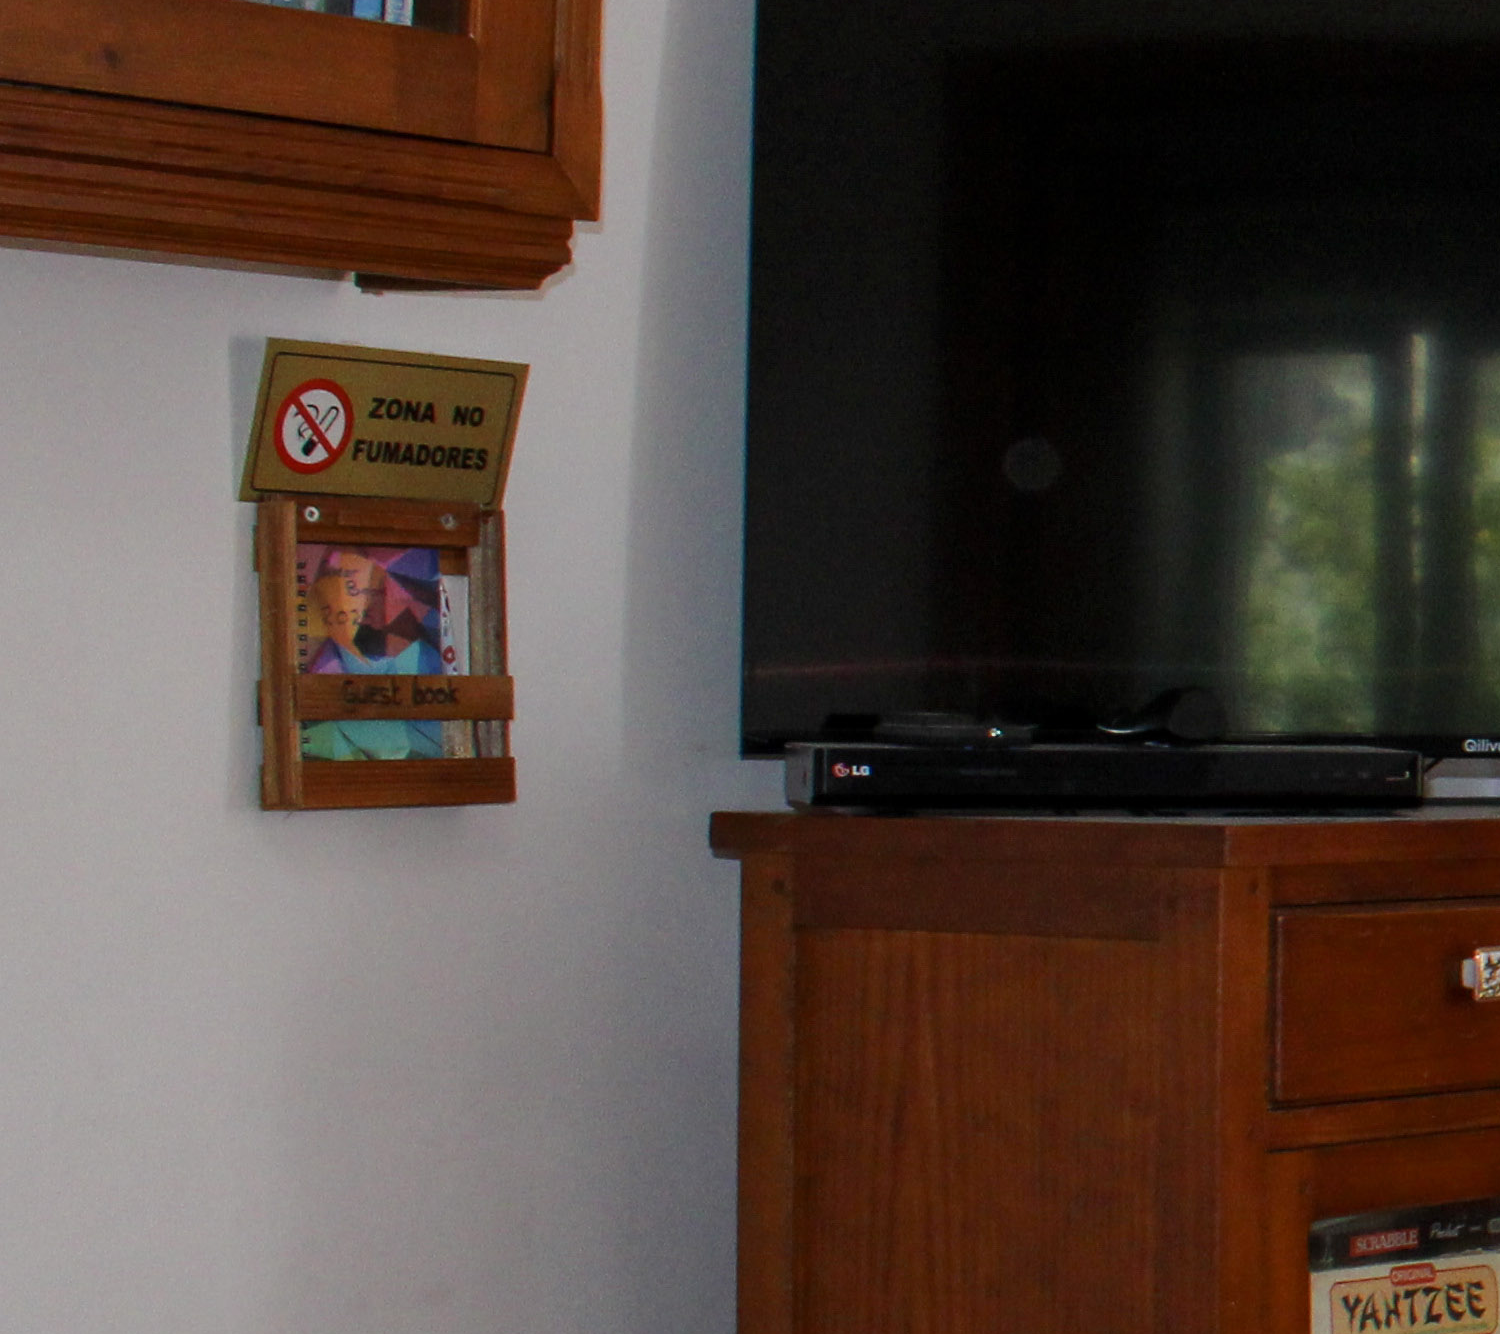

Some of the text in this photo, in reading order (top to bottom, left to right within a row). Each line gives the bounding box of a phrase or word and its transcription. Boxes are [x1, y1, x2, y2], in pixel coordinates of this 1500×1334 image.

[368, 397, 486, 427] ZONA NO
[351, 438, 489, 471] FUMADORES
[851, 764, 871, 777] LG
[1356, 1230, 1419, 1253] SCRABBLE
